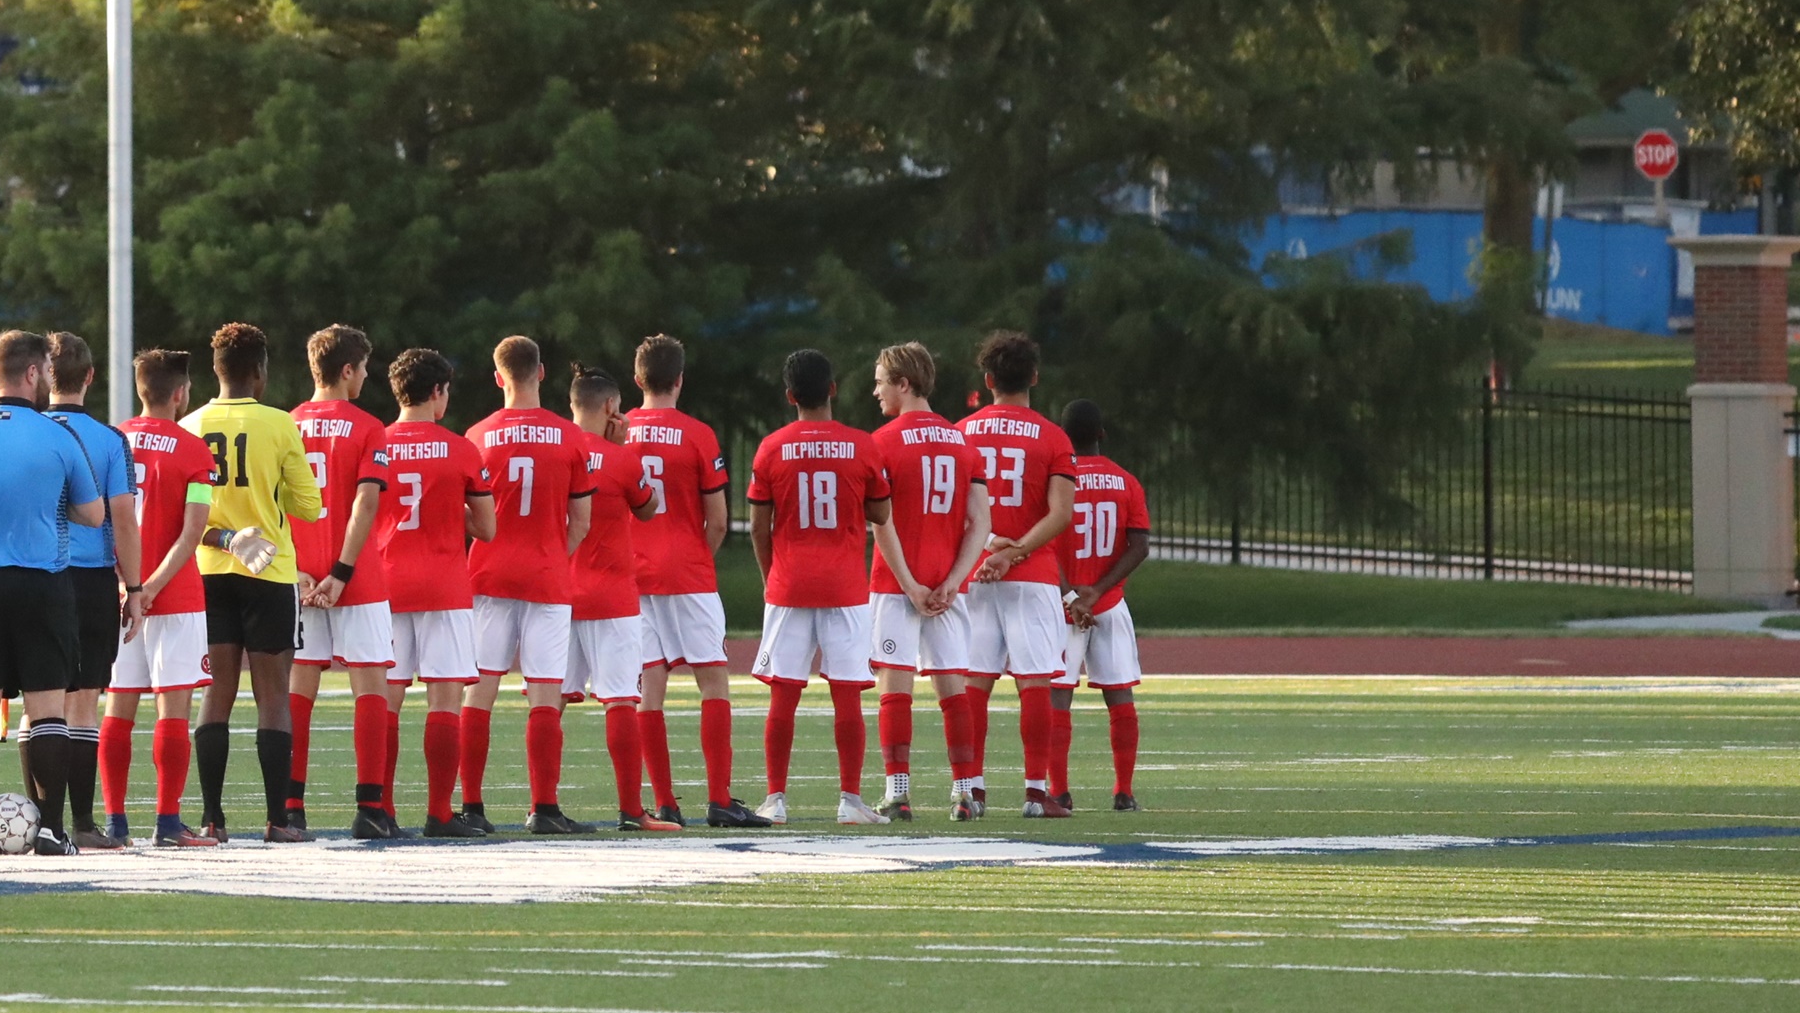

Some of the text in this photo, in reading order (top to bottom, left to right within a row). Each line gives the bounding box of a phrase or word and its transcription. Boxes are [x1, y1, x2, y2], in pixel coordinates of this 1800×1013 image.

[1637, 144, 1676, 165] STOP
[296, 418, 353, 438] PHERSON
[484, 424, 562, 449] MCPHERSON
[901, 426, 966, 446] MCPHERSON
[965, 417, 1041, 439] MCPHERSON
[203, 432, 249, 487] 31
[386, 441, 448, 461] CPHERSON
[782, 441, 855, 461] MCPHERSON
[508, 456, 534, 517] 7
[921, 455, 955, 515] 19
[397, 473, 422, 531] 3
[798, 471, 837, 529] 18
[1073, 501, 1117, 559] 30
